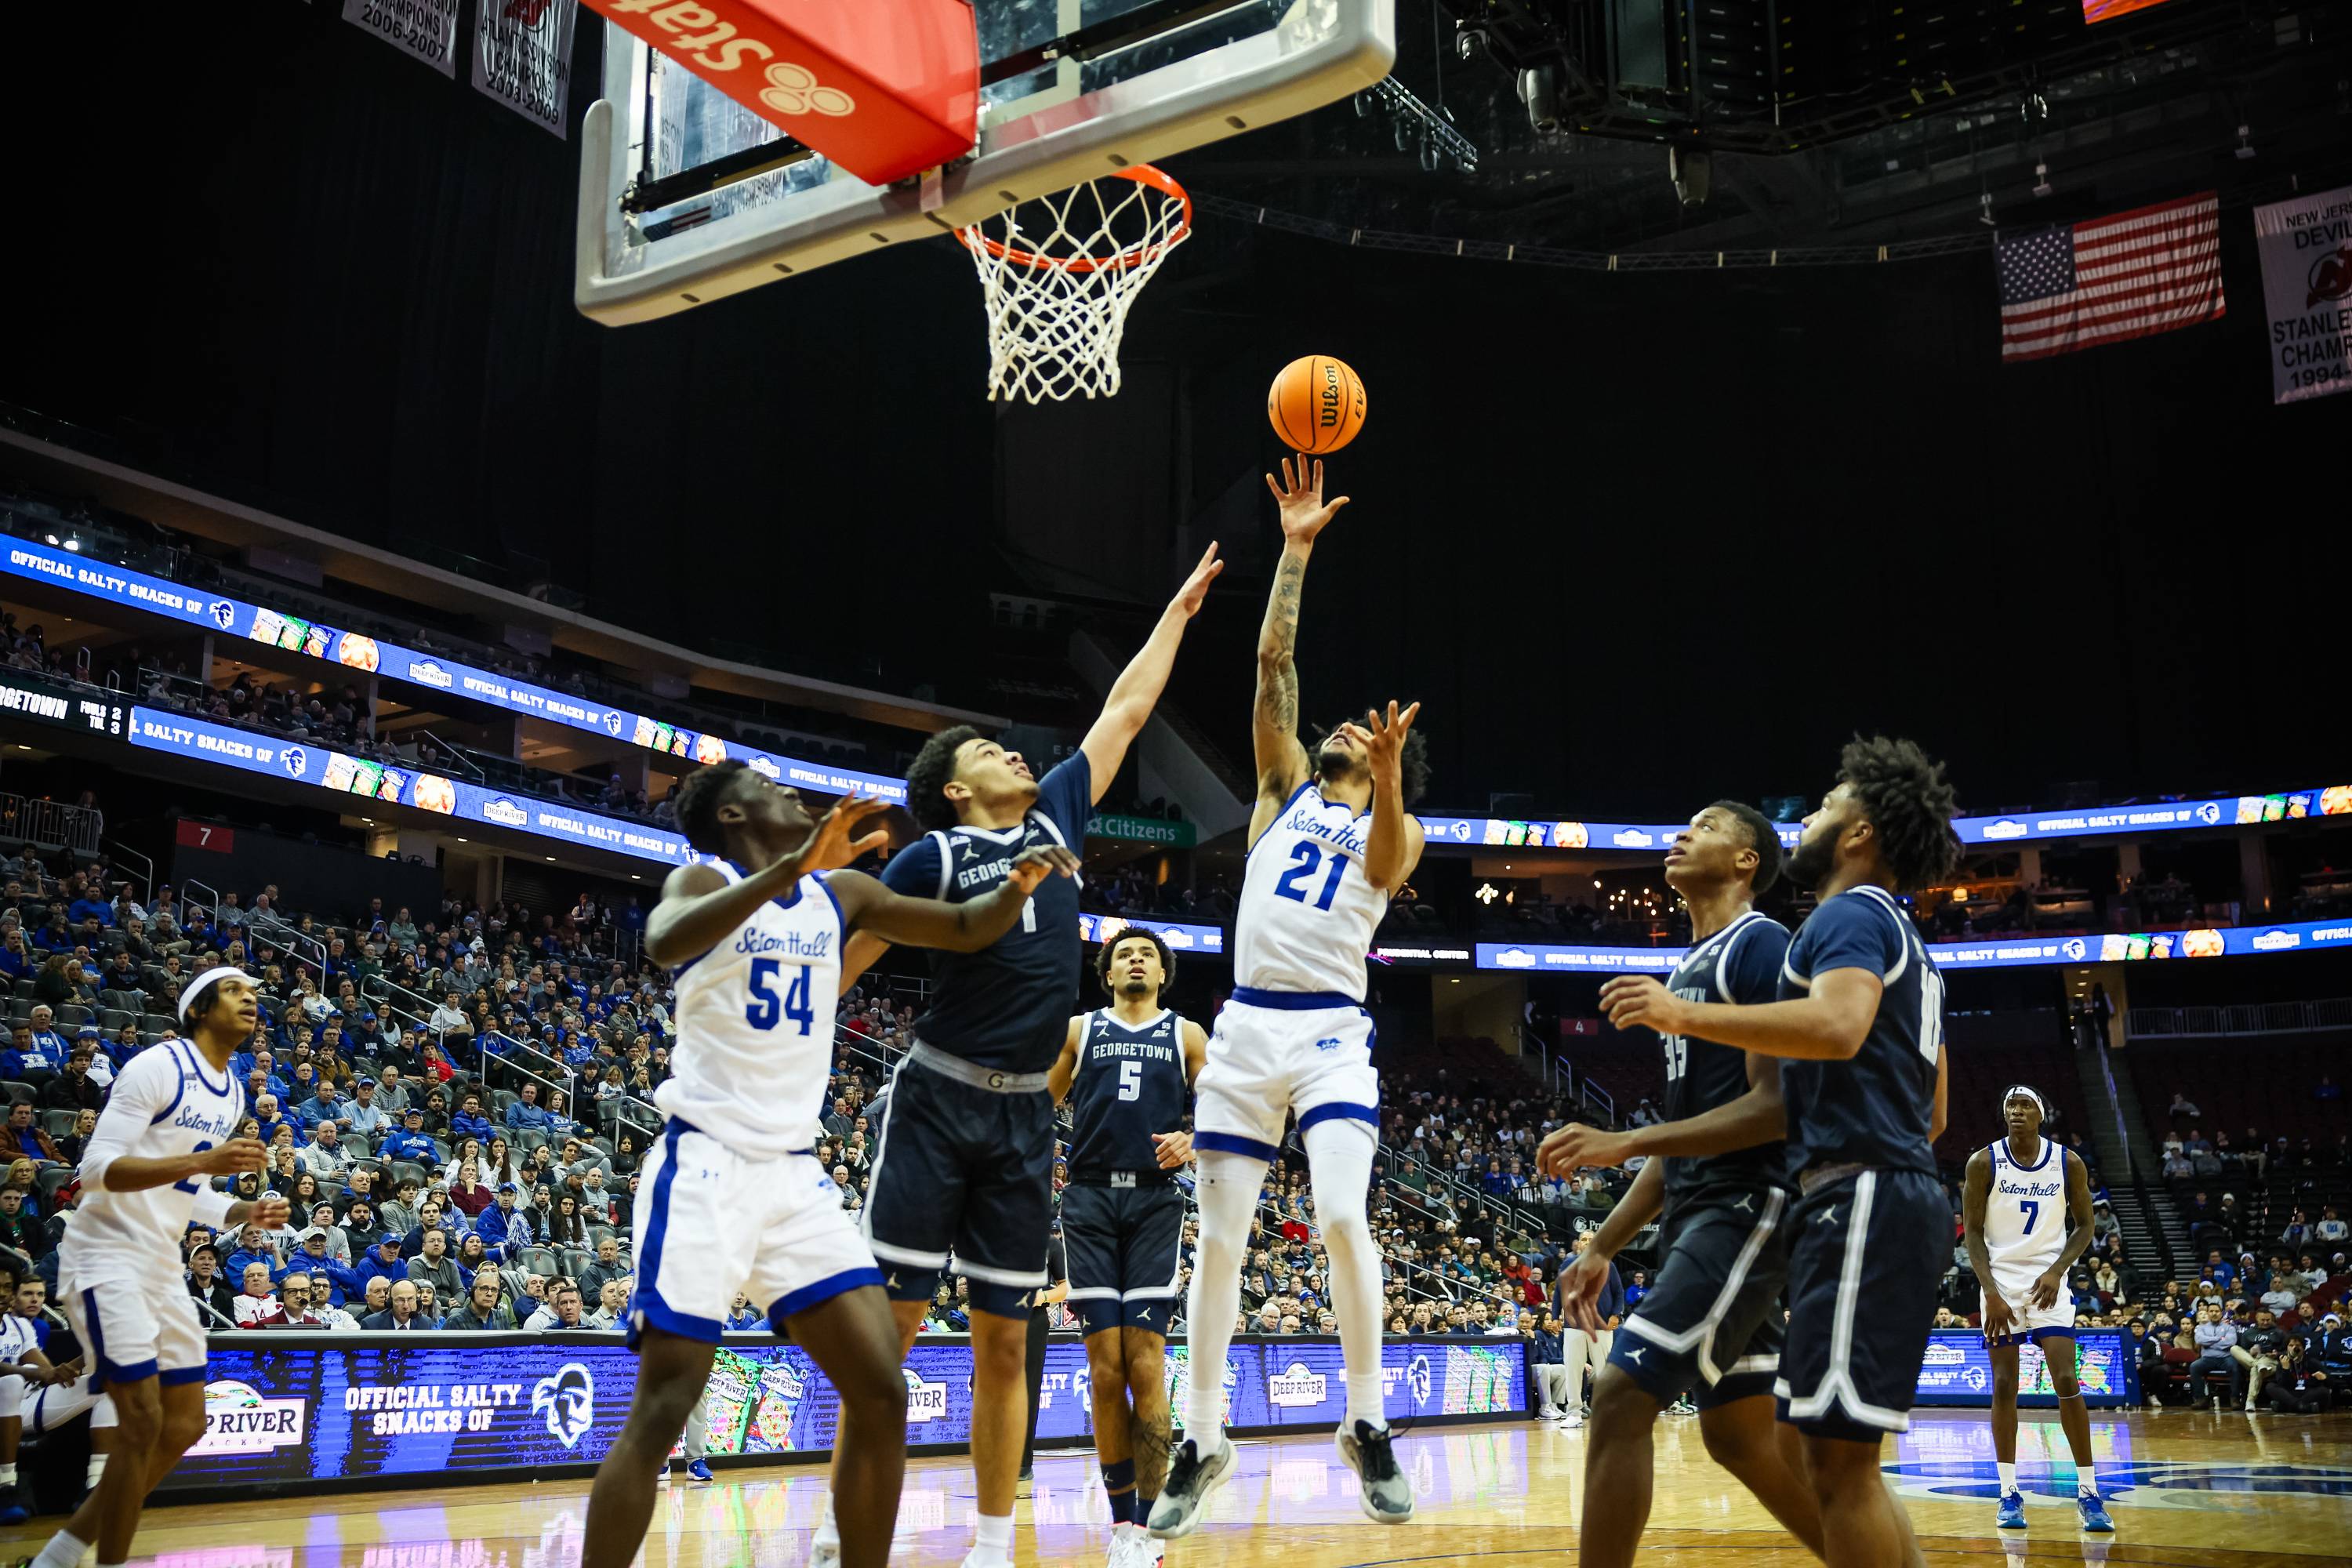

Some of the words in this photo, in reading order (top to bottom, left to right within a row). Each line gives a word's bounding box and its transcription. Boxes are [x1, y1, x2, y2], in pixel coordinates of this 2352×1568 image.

[361, 4, 447, 62] 2006-2007
[486, 71, 559, 125] 2008-2009
[2286, 210, 2318, 227] NEW
[2274, 309, 2352, 343] STANLE
[1321, 365, 1338, 427] Wilson
[10, 550, 74, 579] OFFICIAL
[78, 569, 127, 593] SALTY
[129, 583, 183, 609] SNACKS
[186, 599, 203, 615] OF
[112, 707, 122, 720] 2
[463, 677, 509, 699] OFFICIAL
[510, 690, 545, 710] SALTY
[546, 700, 585, 720] SNACKS
[586, 711, 599, 724] OF
[111, 721, 120, 735] 3
[144, 722, 194, 745] SALTY
[197, 735, 253, 759] SNACKS
[256, 749, 274, 763] OF
[789, 768, 829, 786] OFFICIAL
[830, 776, 863, 791] SALTY
[864, 782, 902, 798] SNACKS
[539, 813, 585, 835] OFFICIAL
[587, 826, 622, 843] SALTY
[624, 833, 663, 852] SNACKS
[665, 842, 677, 855] OF
[1105, 818, 1176, 841] Citizens
[1287, 809, 1331, 839] Seton
[2038, 815, 2088, 831] OFFICIAL
[2088, 815, 2127, 827] SALTY
[199, 828, 212, 846] 7
[1274, 840, 1350, 912] 21
[735, 927, 785, 953] Seton
[786, 931, 833, 958] Hall
[1433, 949, 1469, 960] CENTER
[1957, 949, 1995, 960] SALTY
[746, 956, 815, 1036] 54
[1575, 1021, 1584, 1033] 4
[1093, 1043, 1173, 1062] GEORGETOWN
[1118, 1060, 1142, 1102] 5
[176, 1105, 212, 1133] Seton
[1999, 1179, 2028, 1196] Seton
[2029, 1181, 2061, 1196] Hall
[2020, 1200, 2039, 1235] 7
[1936, 1352, 1962, 1362] RIVER
[708, 1374, 725, 1387] DEEP
[725, 1381, 746, 1396] RIVER
[764, 1371, 779, 1384] DEEP
[780, 1379, 801, 1393] RIVER
[1273, 1381, 1295, 1396] DEEP
[1297, 1381, 1323, 1395] RIVER
[345, 1386, 446, 1410] OFFICIAL
[450, 1384, 522, 1407] SALTY
[219, 1409, 297, 1434] RIVER
[372, 1409, 466, 1436] SNACKS
[467, 1408, 495, 1432] OF
